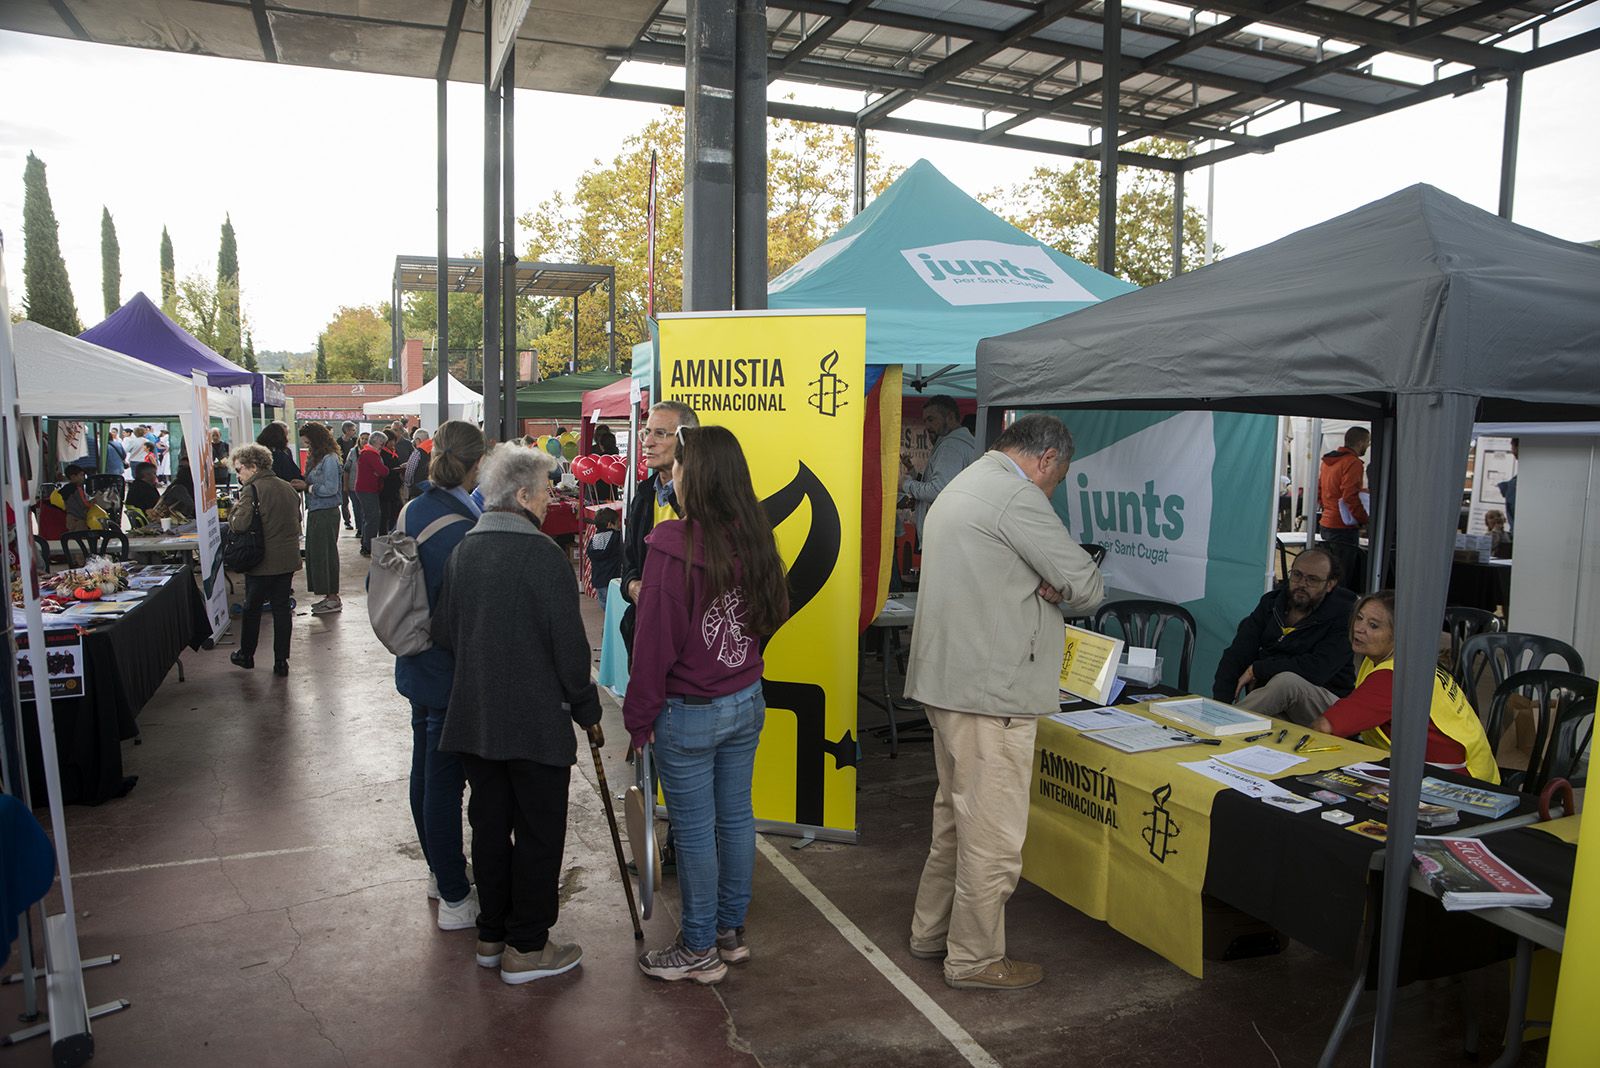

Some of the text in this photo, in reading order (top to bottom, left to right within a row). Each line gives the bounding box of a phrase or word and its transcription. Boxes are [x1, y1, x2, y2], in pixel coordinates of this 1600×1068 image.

[917, 252, 1054, 285] junts
[953, 276, 1050, 290] per Sant Cugat
[670, 358, 785, 388] AMNISTIA
[1077, 472, 1185, 544] junts
[1114, 539, 1135, 556] Sant
[1137, 543, 1169, 565] Cugat
[1040, 748, 1118, 805] AMNISTÍA
[1040, 778, 1119, 829] INTERNACIONAL
